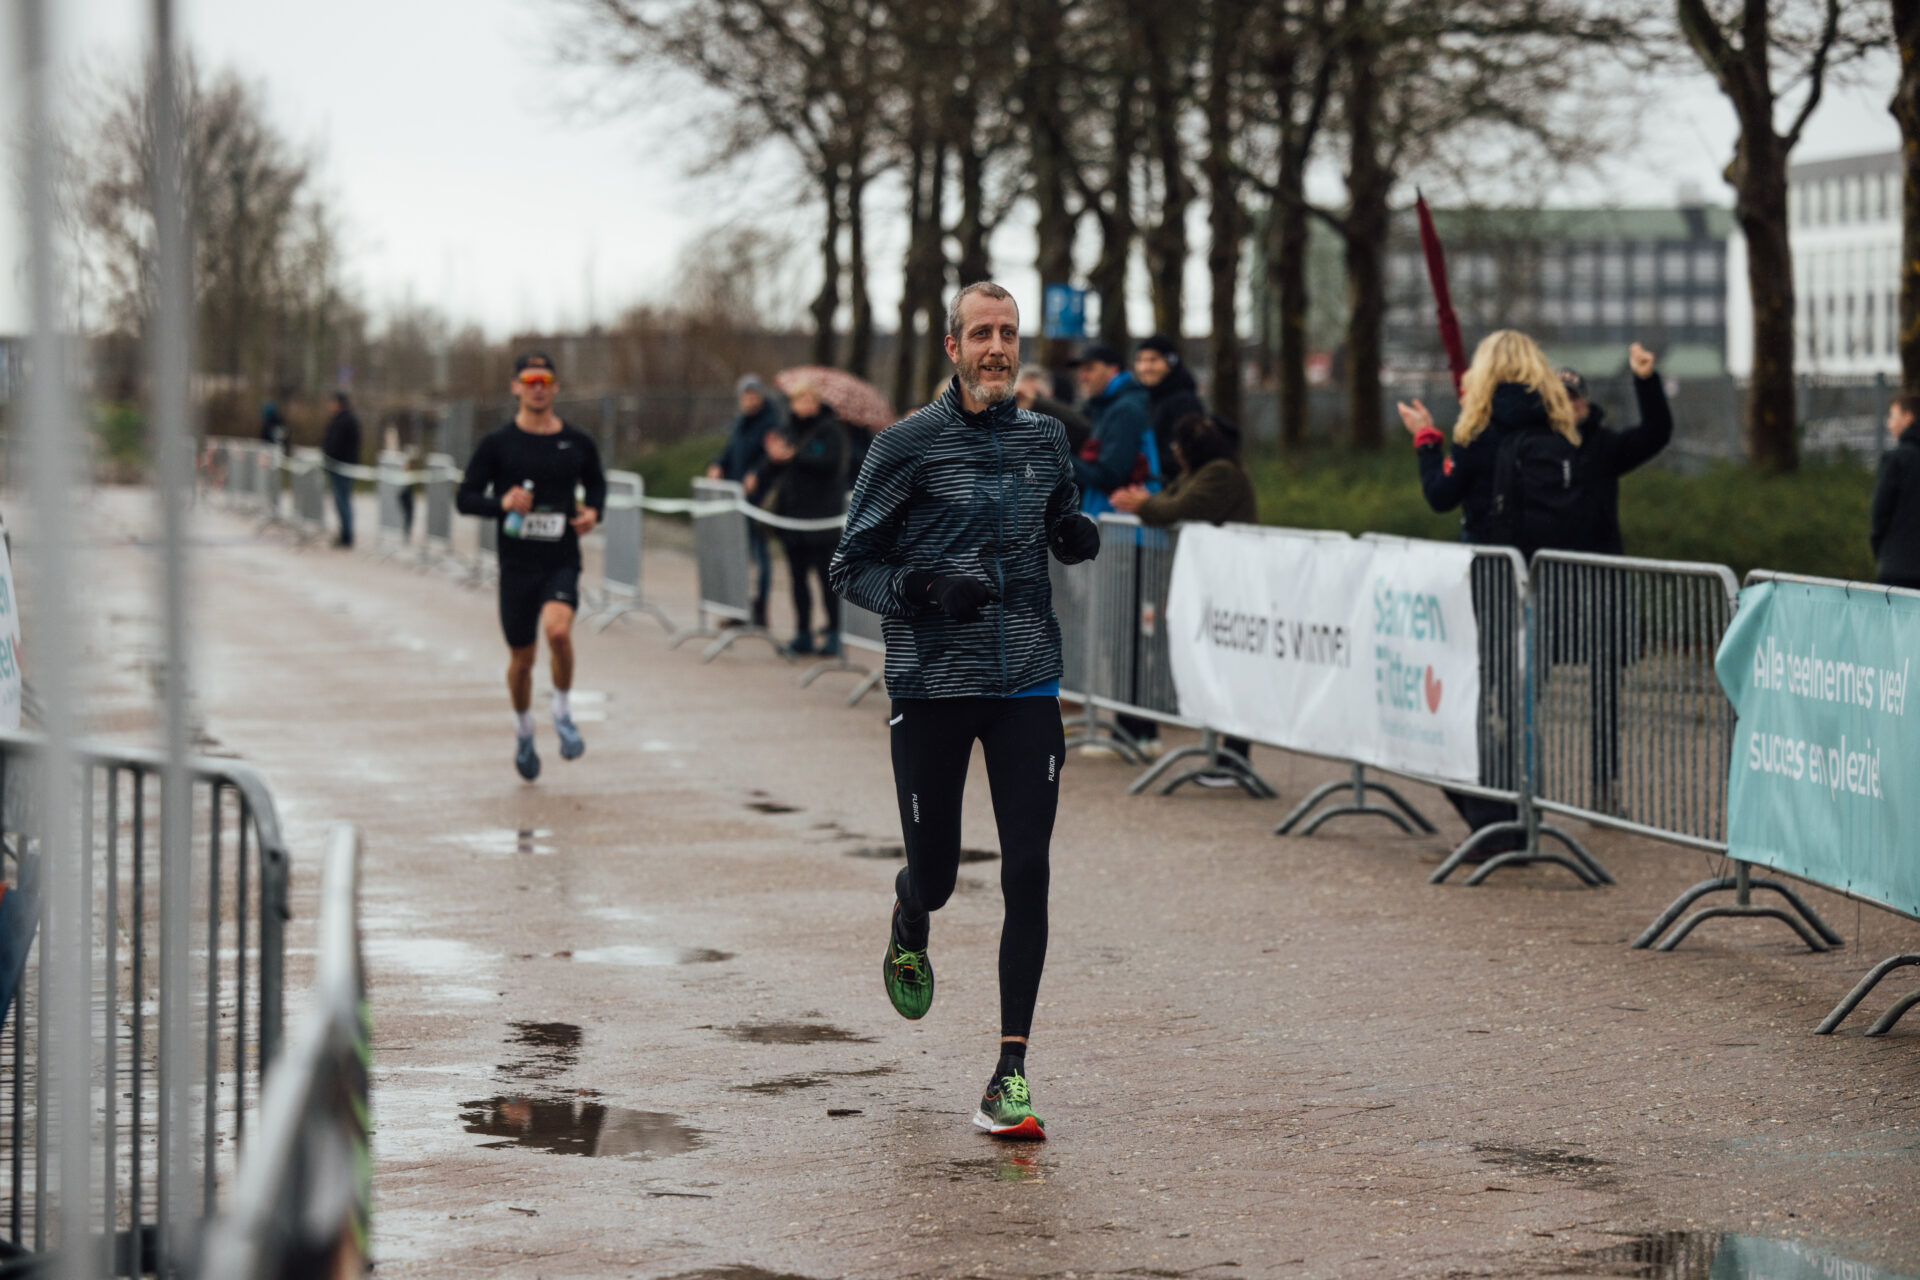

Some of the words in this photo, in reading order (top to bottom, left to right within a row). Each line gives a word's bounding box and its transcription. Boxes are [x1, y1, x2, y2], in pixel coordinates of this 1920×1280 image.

[1753, 635, 1784, 691] Alle
[1879, 658, 1909, 716] veel
[1048, 754, 1056, 782] FUSION
[1809, 743, 1828, 786] en
[911, 792, 920, 823] FUSION
